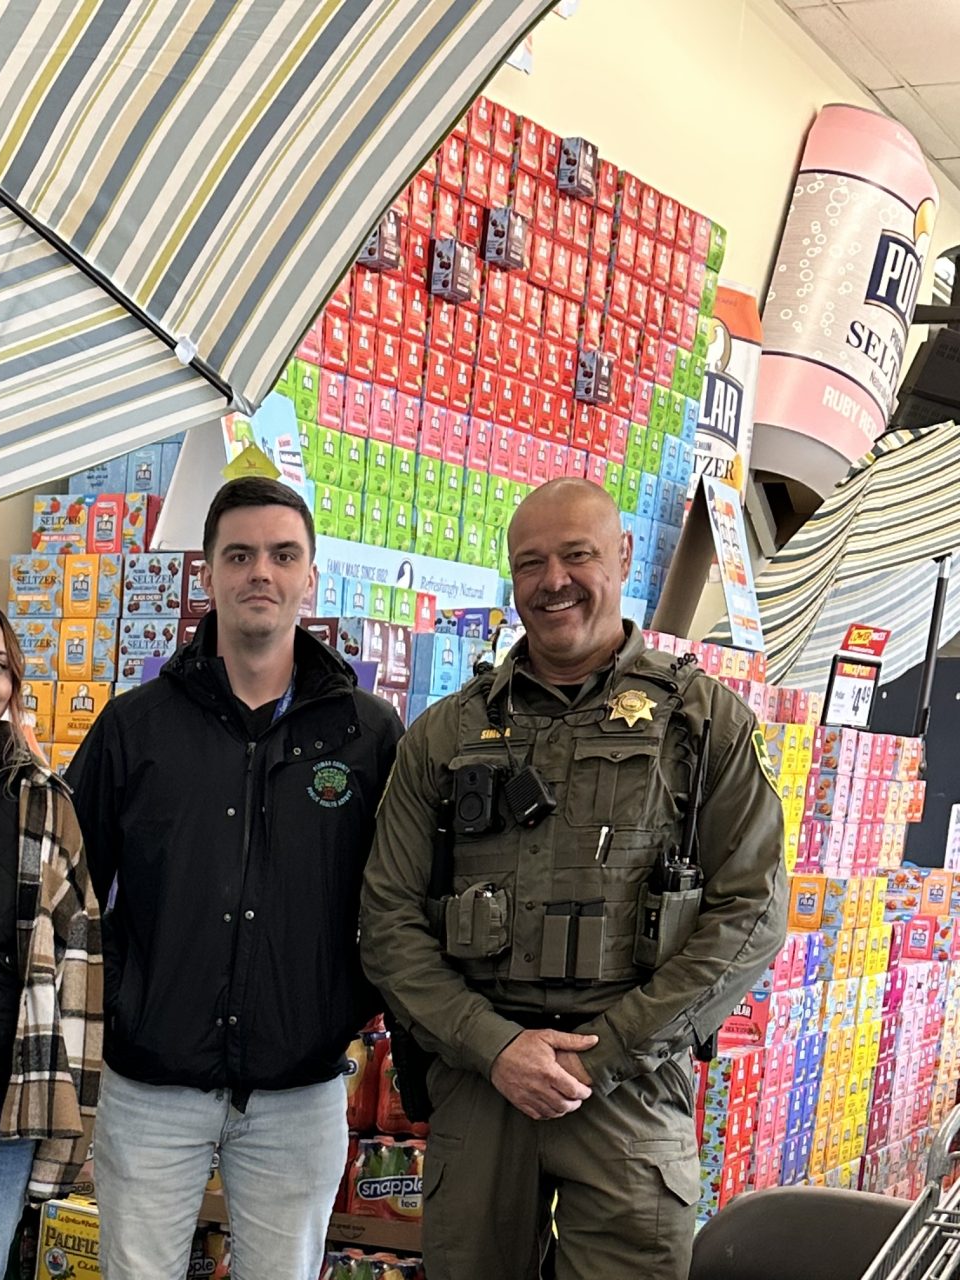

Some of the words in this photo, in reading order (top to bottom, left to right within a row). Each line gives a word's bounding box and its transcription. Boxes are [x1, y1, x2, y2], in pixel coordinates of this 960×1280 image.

[699, 375, 739, 438] LAR
[822, 385, 860, 424] RUBY
[693, 454, 735, 481] TZER
[132, 575, 175, 584] SELTZER
[327, 558, 345, 574] FAMILY
[346, 563, 360, 578] MADE
[361, 565, 376, 581] SINCE
[420, 576, 459, 598] Refreshingly
[461, 582, 485, 600] Natural
[400, 1199, 417, 1208] tea
[45, 1225, 99, 1256] PACIFIC
